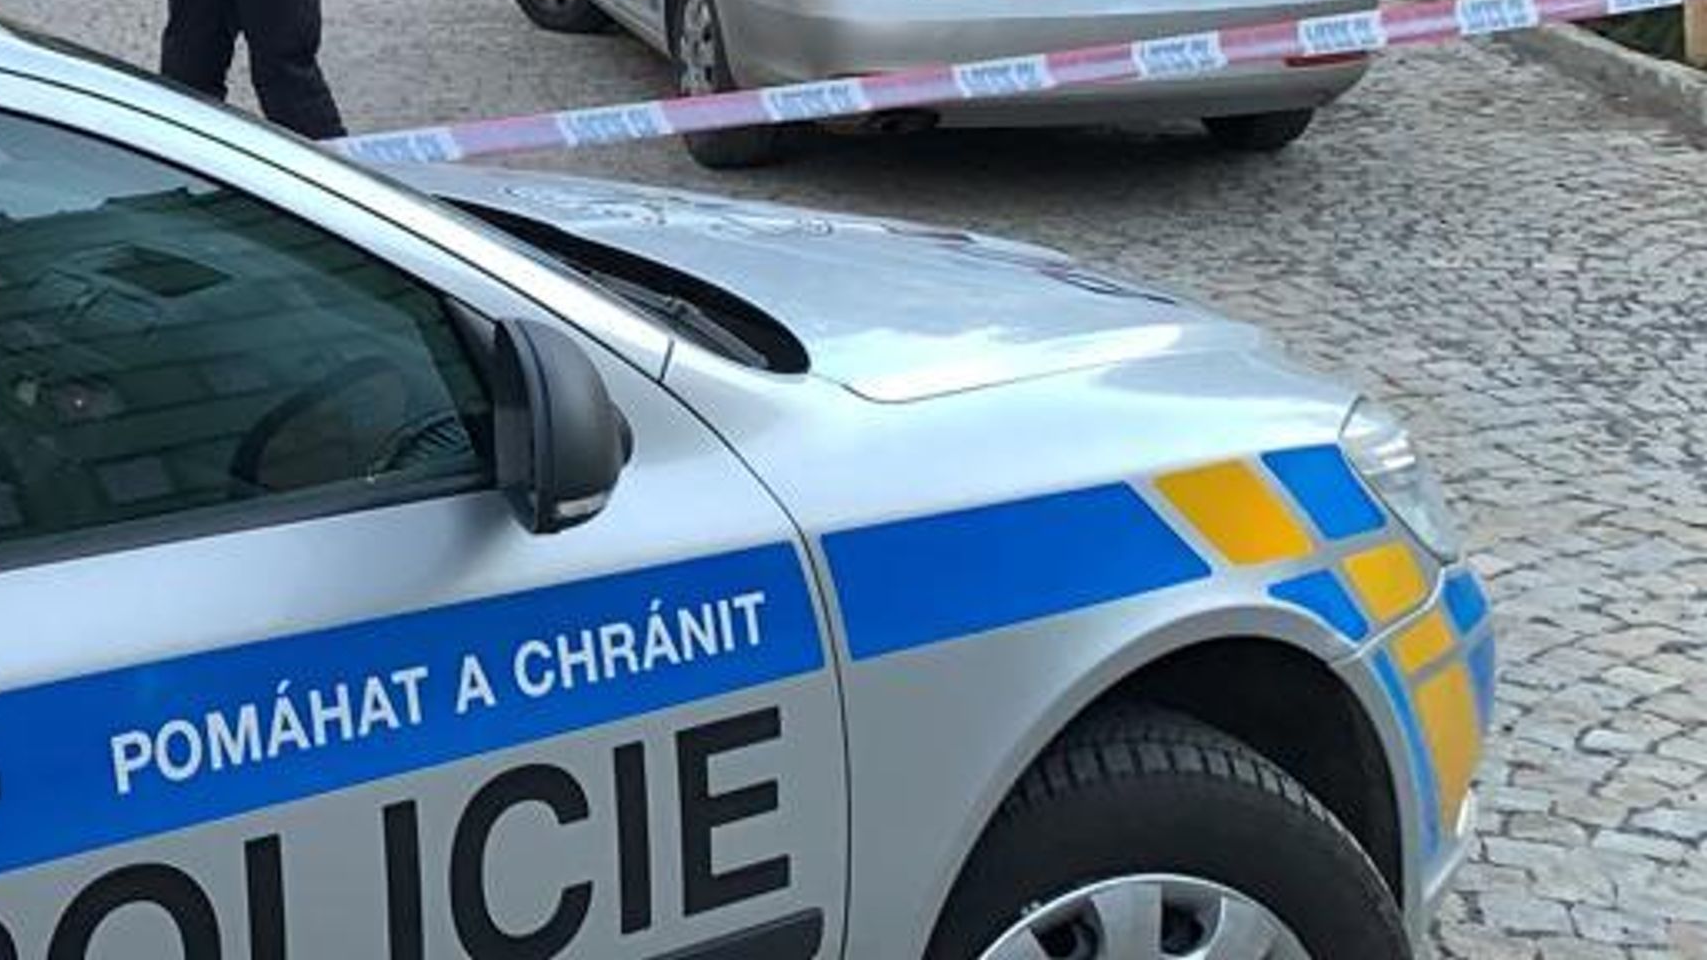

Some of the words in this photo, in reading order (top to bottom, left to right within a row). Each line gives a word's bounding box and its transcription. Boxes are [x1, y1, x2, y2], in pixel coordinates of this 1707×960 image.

[111, 664, 430, 794] POMÁHAT
[455, 654, 498, 716] A
[513, 591, 768, 699] CHRÁNIT
